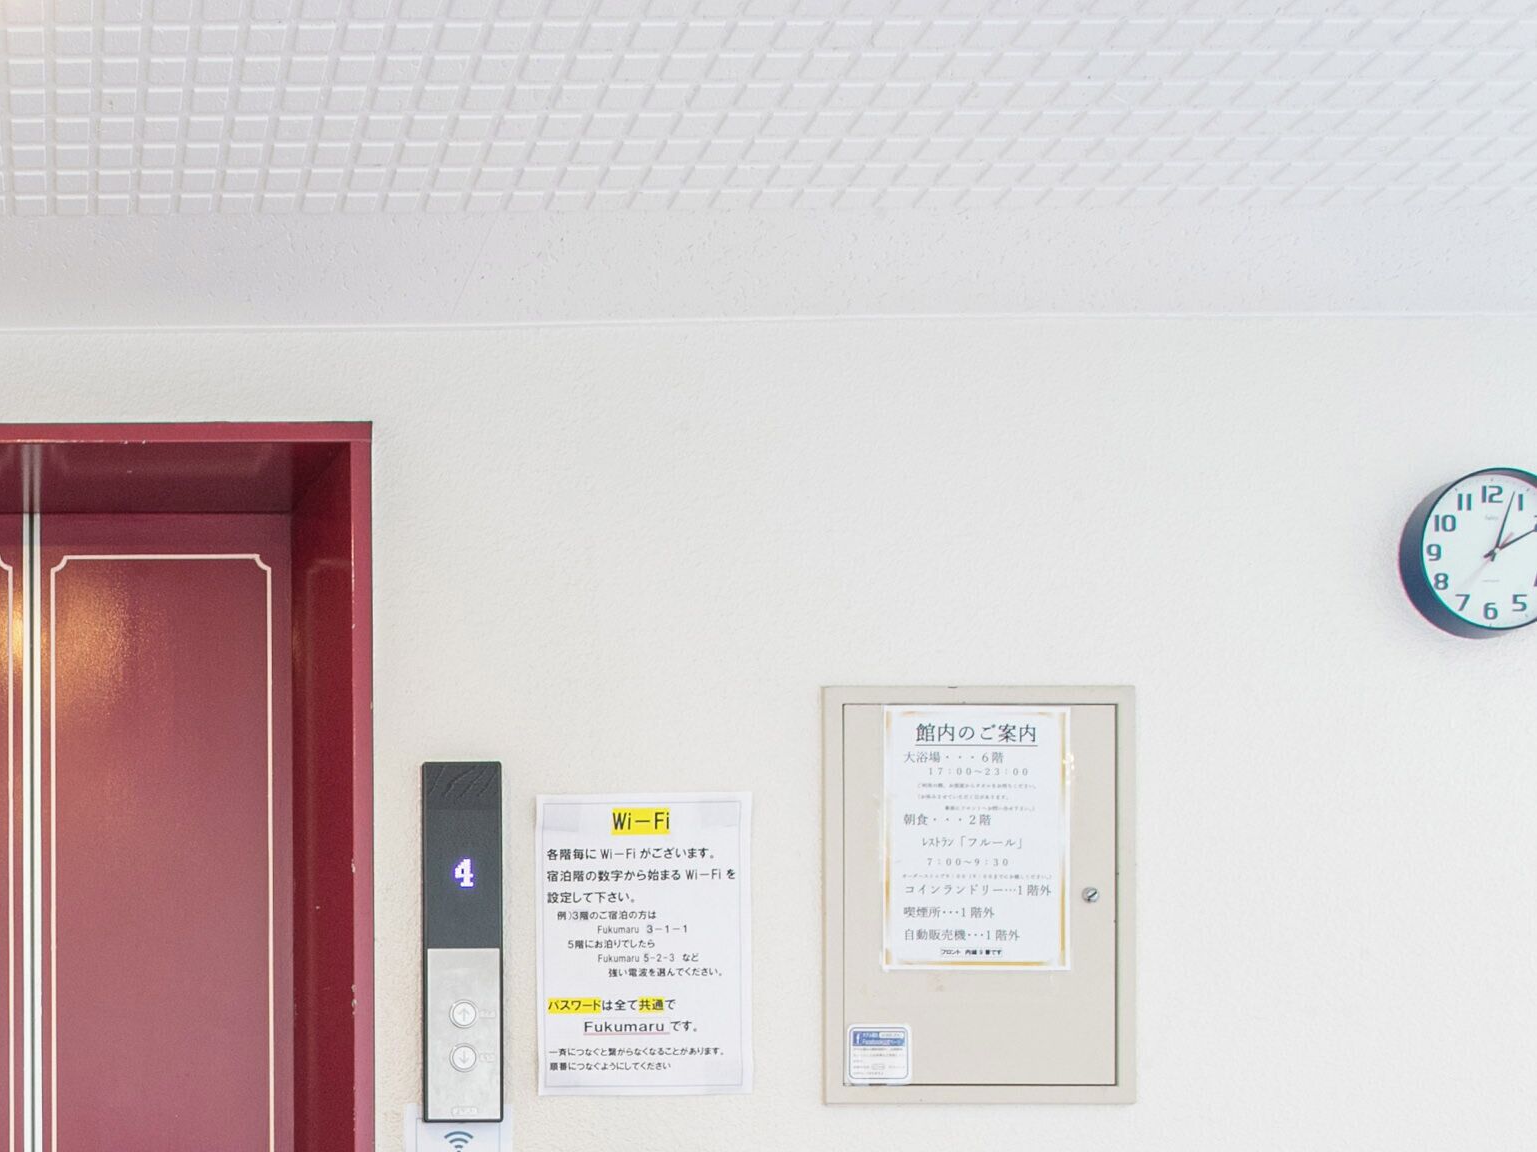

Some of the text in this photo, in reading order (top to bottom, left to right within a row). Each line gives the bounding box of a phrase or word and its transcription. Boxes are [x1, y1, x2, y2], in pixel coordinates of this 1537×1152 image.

[1458, 494, 1471, 510] 11
[1482, 486, 1502, 503] 12
[1519, 494, 1523, 510] 1
[1435, 515, 1456, 531] 10
[1427, 544, 1441, 561] 9
[1434, 573, 1449, 591] 8
[1455, 594, 1470, 611] 7
[1513, 594, 1527, 611] 5
[1484, 603, 1497, 619] 6
[916, 723, 1035, 742] 館内のご案内
[455, 859, 473, 887] 4
[547, 892, 634, 903] 設定して下さい。
[598, 926, 639, 934] Fukumaru
[568, 940, 654, 949] 5階にお泊りでしたら
[598, 954, 639, 962] Fukumaru
[683, 954, 698, 962] など
[609, 968, 721, 977] 強い電波を選んでください。
[548, 999, 676, 1011] パスワードは全て共通で
[585, 1021, 696, 1032] Fukumaru です。
[550, 1062, 670, 1071] 順番につなぐようにしてください
